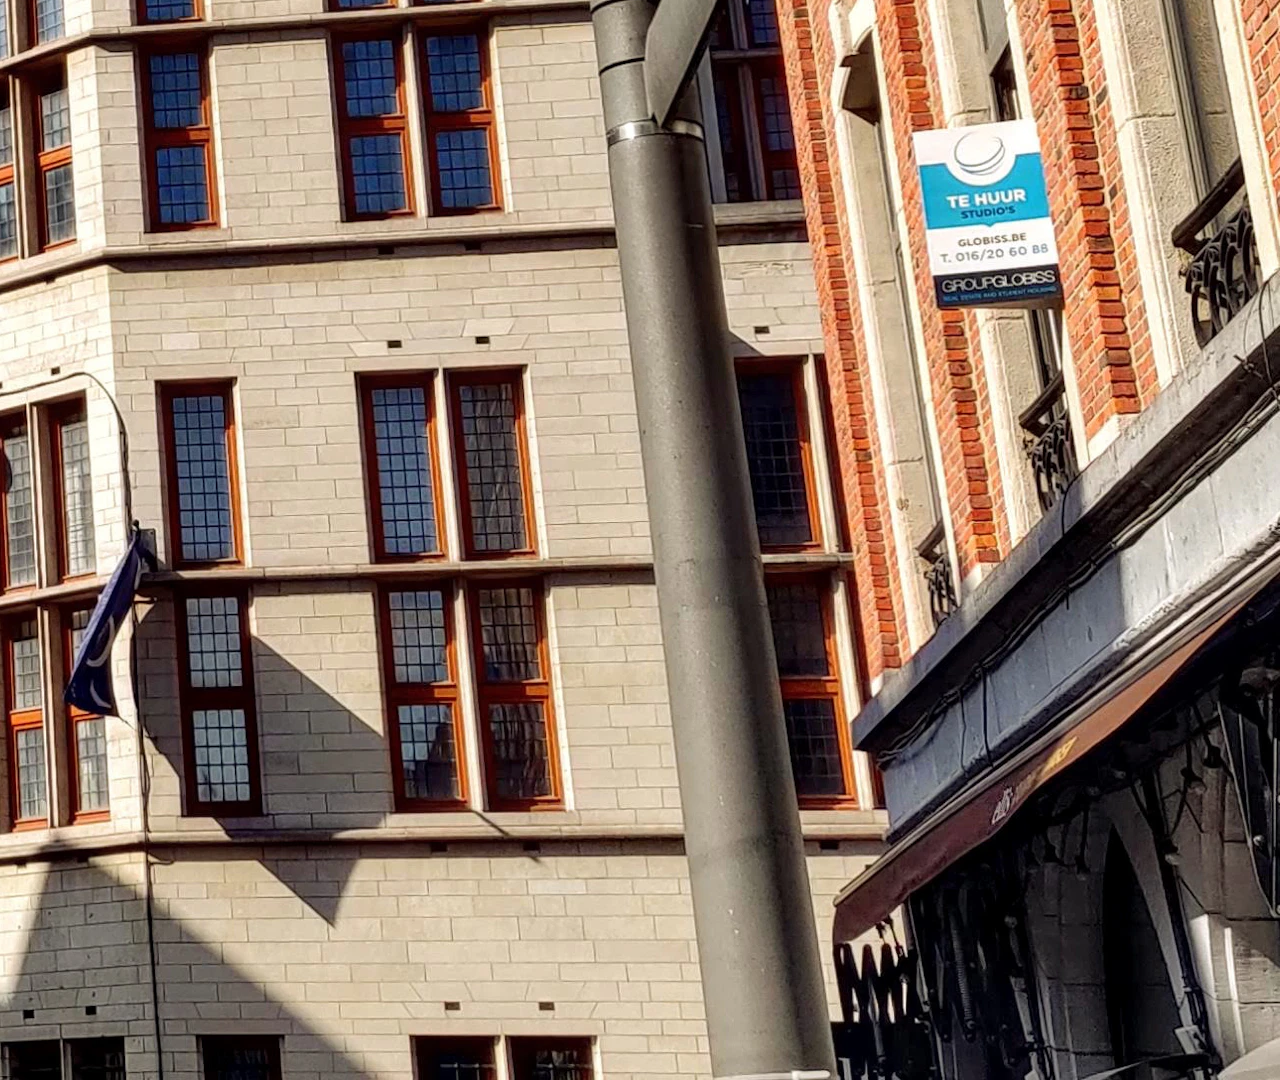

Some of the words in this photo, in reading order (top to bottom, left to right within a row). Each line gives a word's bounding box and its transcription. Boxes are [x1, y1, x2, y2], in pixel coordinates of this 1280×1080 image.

[946, 194, 971, 209] TE
[974, 188, 1027, 206] HUUR
[960, 205, 1016, 219] STUDIO'S
[957, 232, 1027, 247] GLOBISS.BE
[940, 253, 952, 263] T.
[955, 248, 1005, 262] 016/20
[1009, 246, 1028, 257] 60
[942, 270, 1056, 293] GROUPGLOBISS
